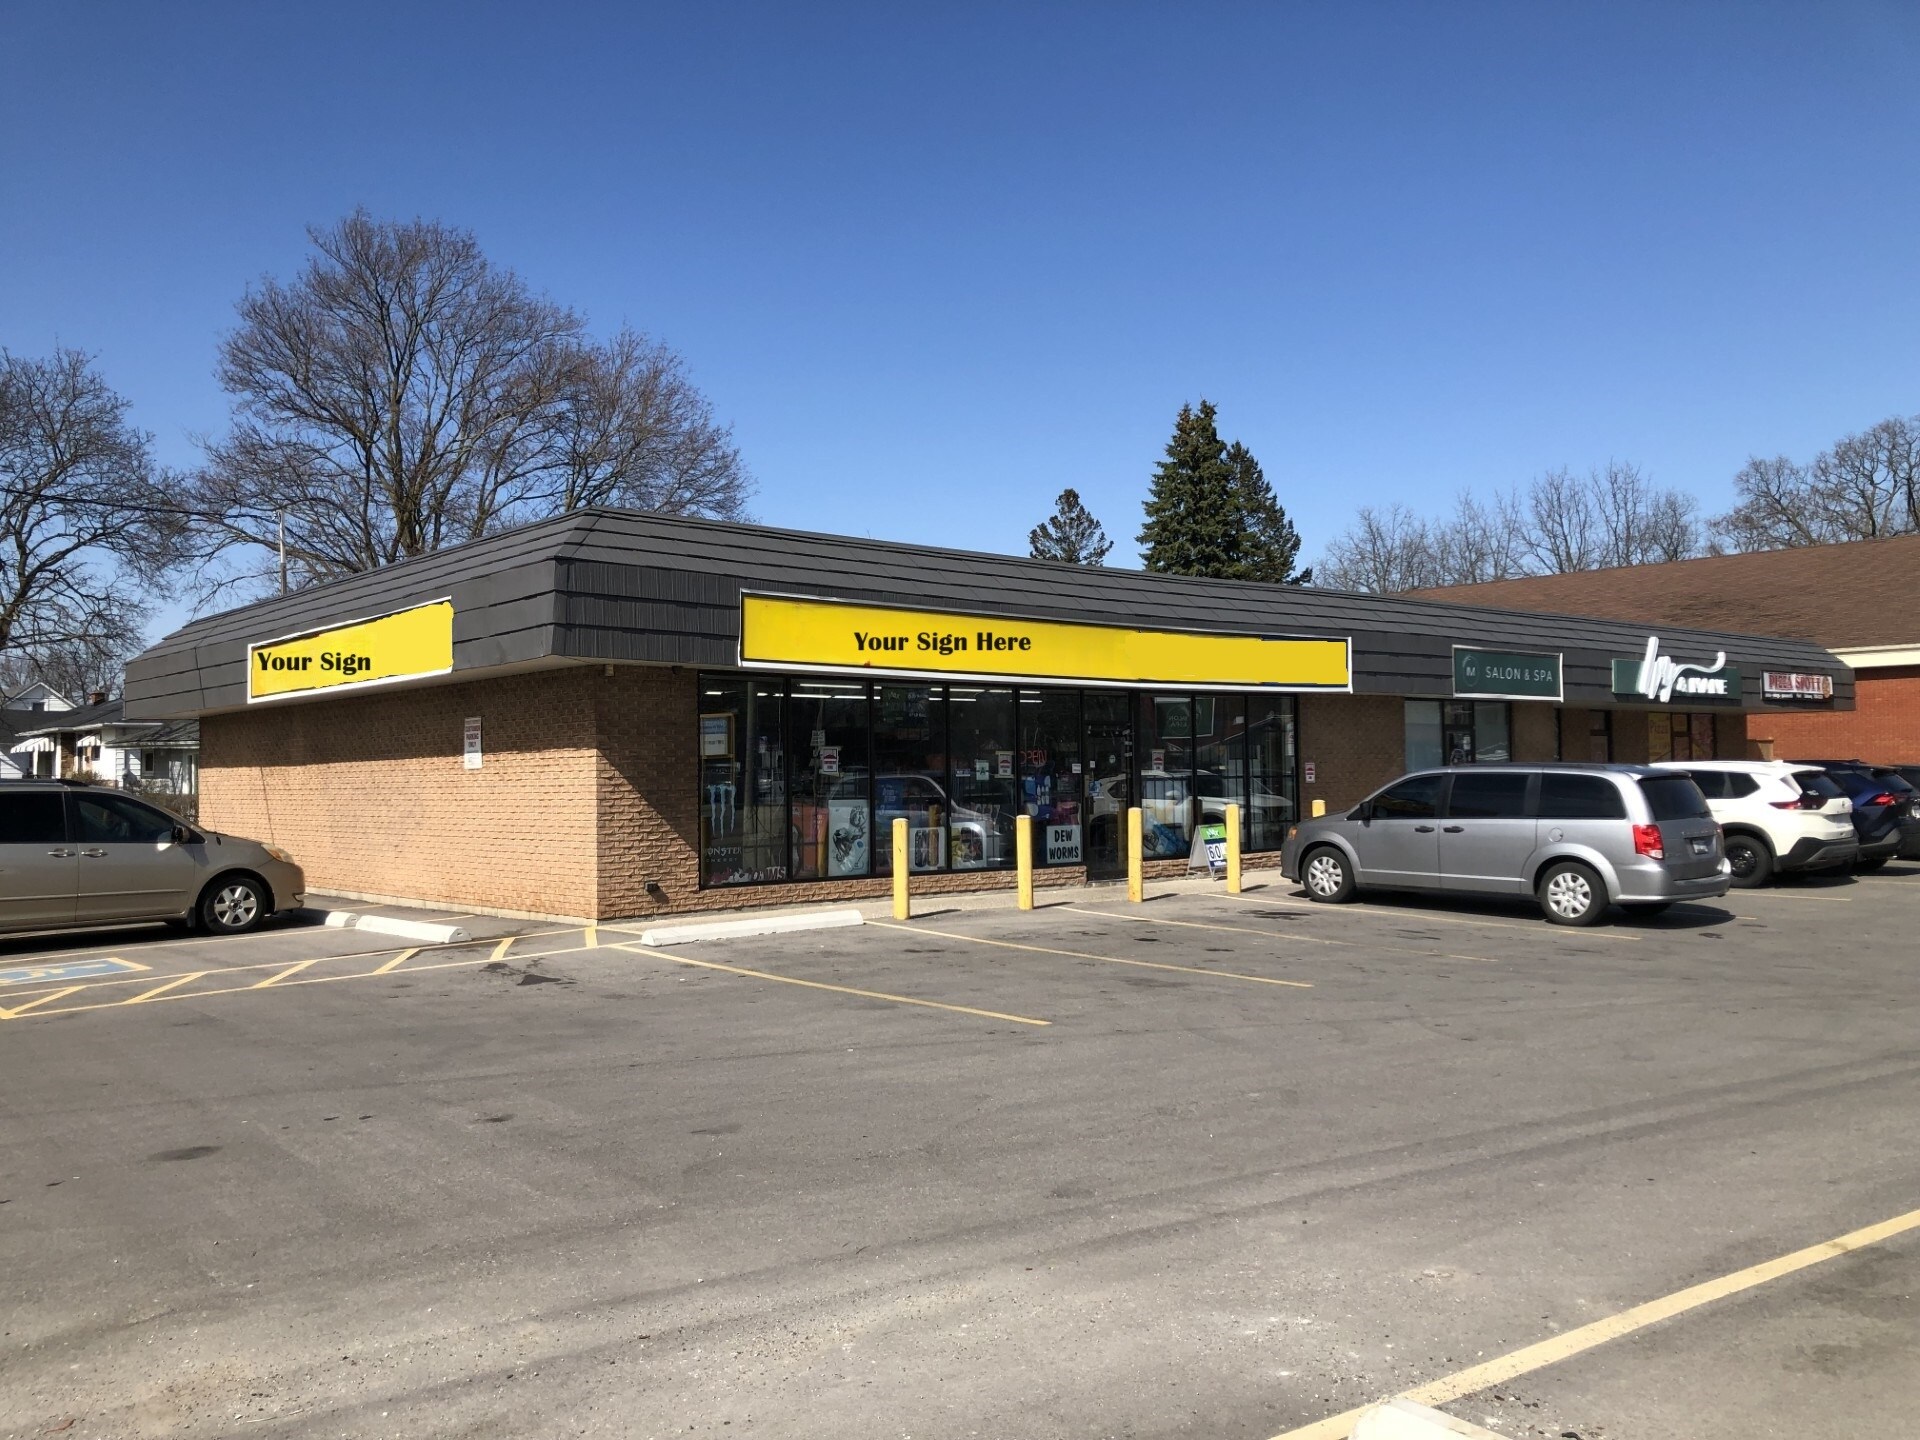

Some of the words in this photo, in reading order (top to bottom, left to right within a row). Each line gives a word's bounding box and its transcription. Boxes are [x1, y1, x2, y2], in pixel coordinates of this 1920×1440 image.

[854, 632, 909, 651] Your
[917, 632, 967, 655] Sign
[977, 632, 1031, 651] Here
[257, 652, 312, 671] Your
[321, 652, 370, 675] Sign
[1485, 666, 1520, 680] SALON
[1524, 669, 1530, 680] &
[1534, 669, 1553, 682] SPA
[1054, 829, 1073, 843] DEW
[1049, 846, 1079, 860] WORMS
[1208, 845, 1221, 859] 60
